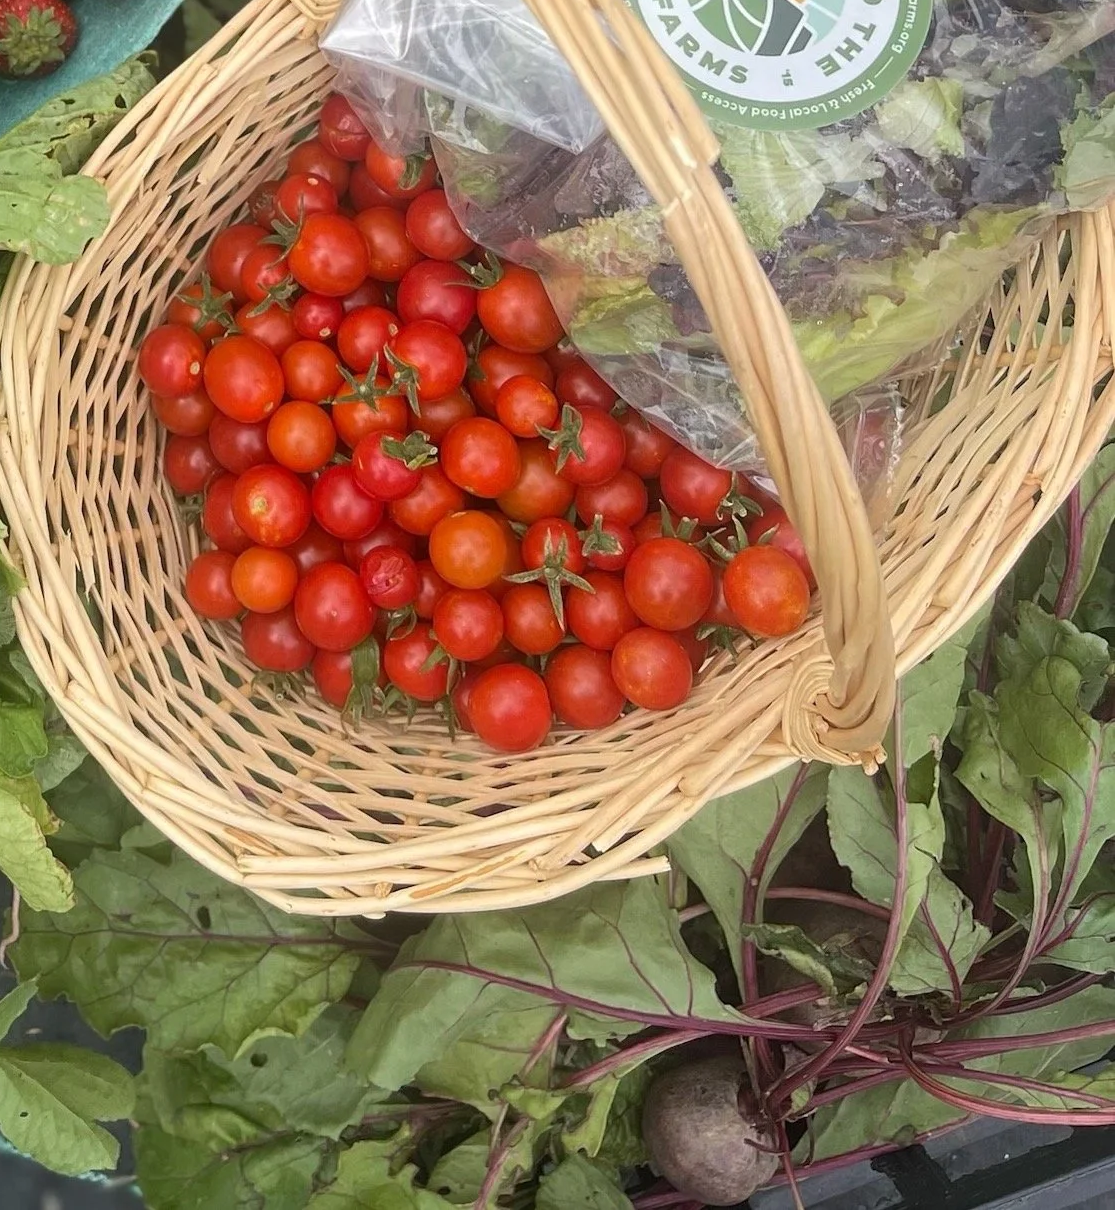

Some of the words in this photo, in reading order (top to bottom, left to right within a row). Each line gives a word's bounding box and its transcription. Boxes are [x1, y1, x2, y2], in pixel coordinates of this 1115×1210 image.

[814, 22, 876, 78] THE
[840, 79, 876, 104] Fresh
[701, 91, 748, 115] Access
[751, 107, 786, 119] Food
[789, 102, 828, 119] Local
[827, 100, 841, 110] &
